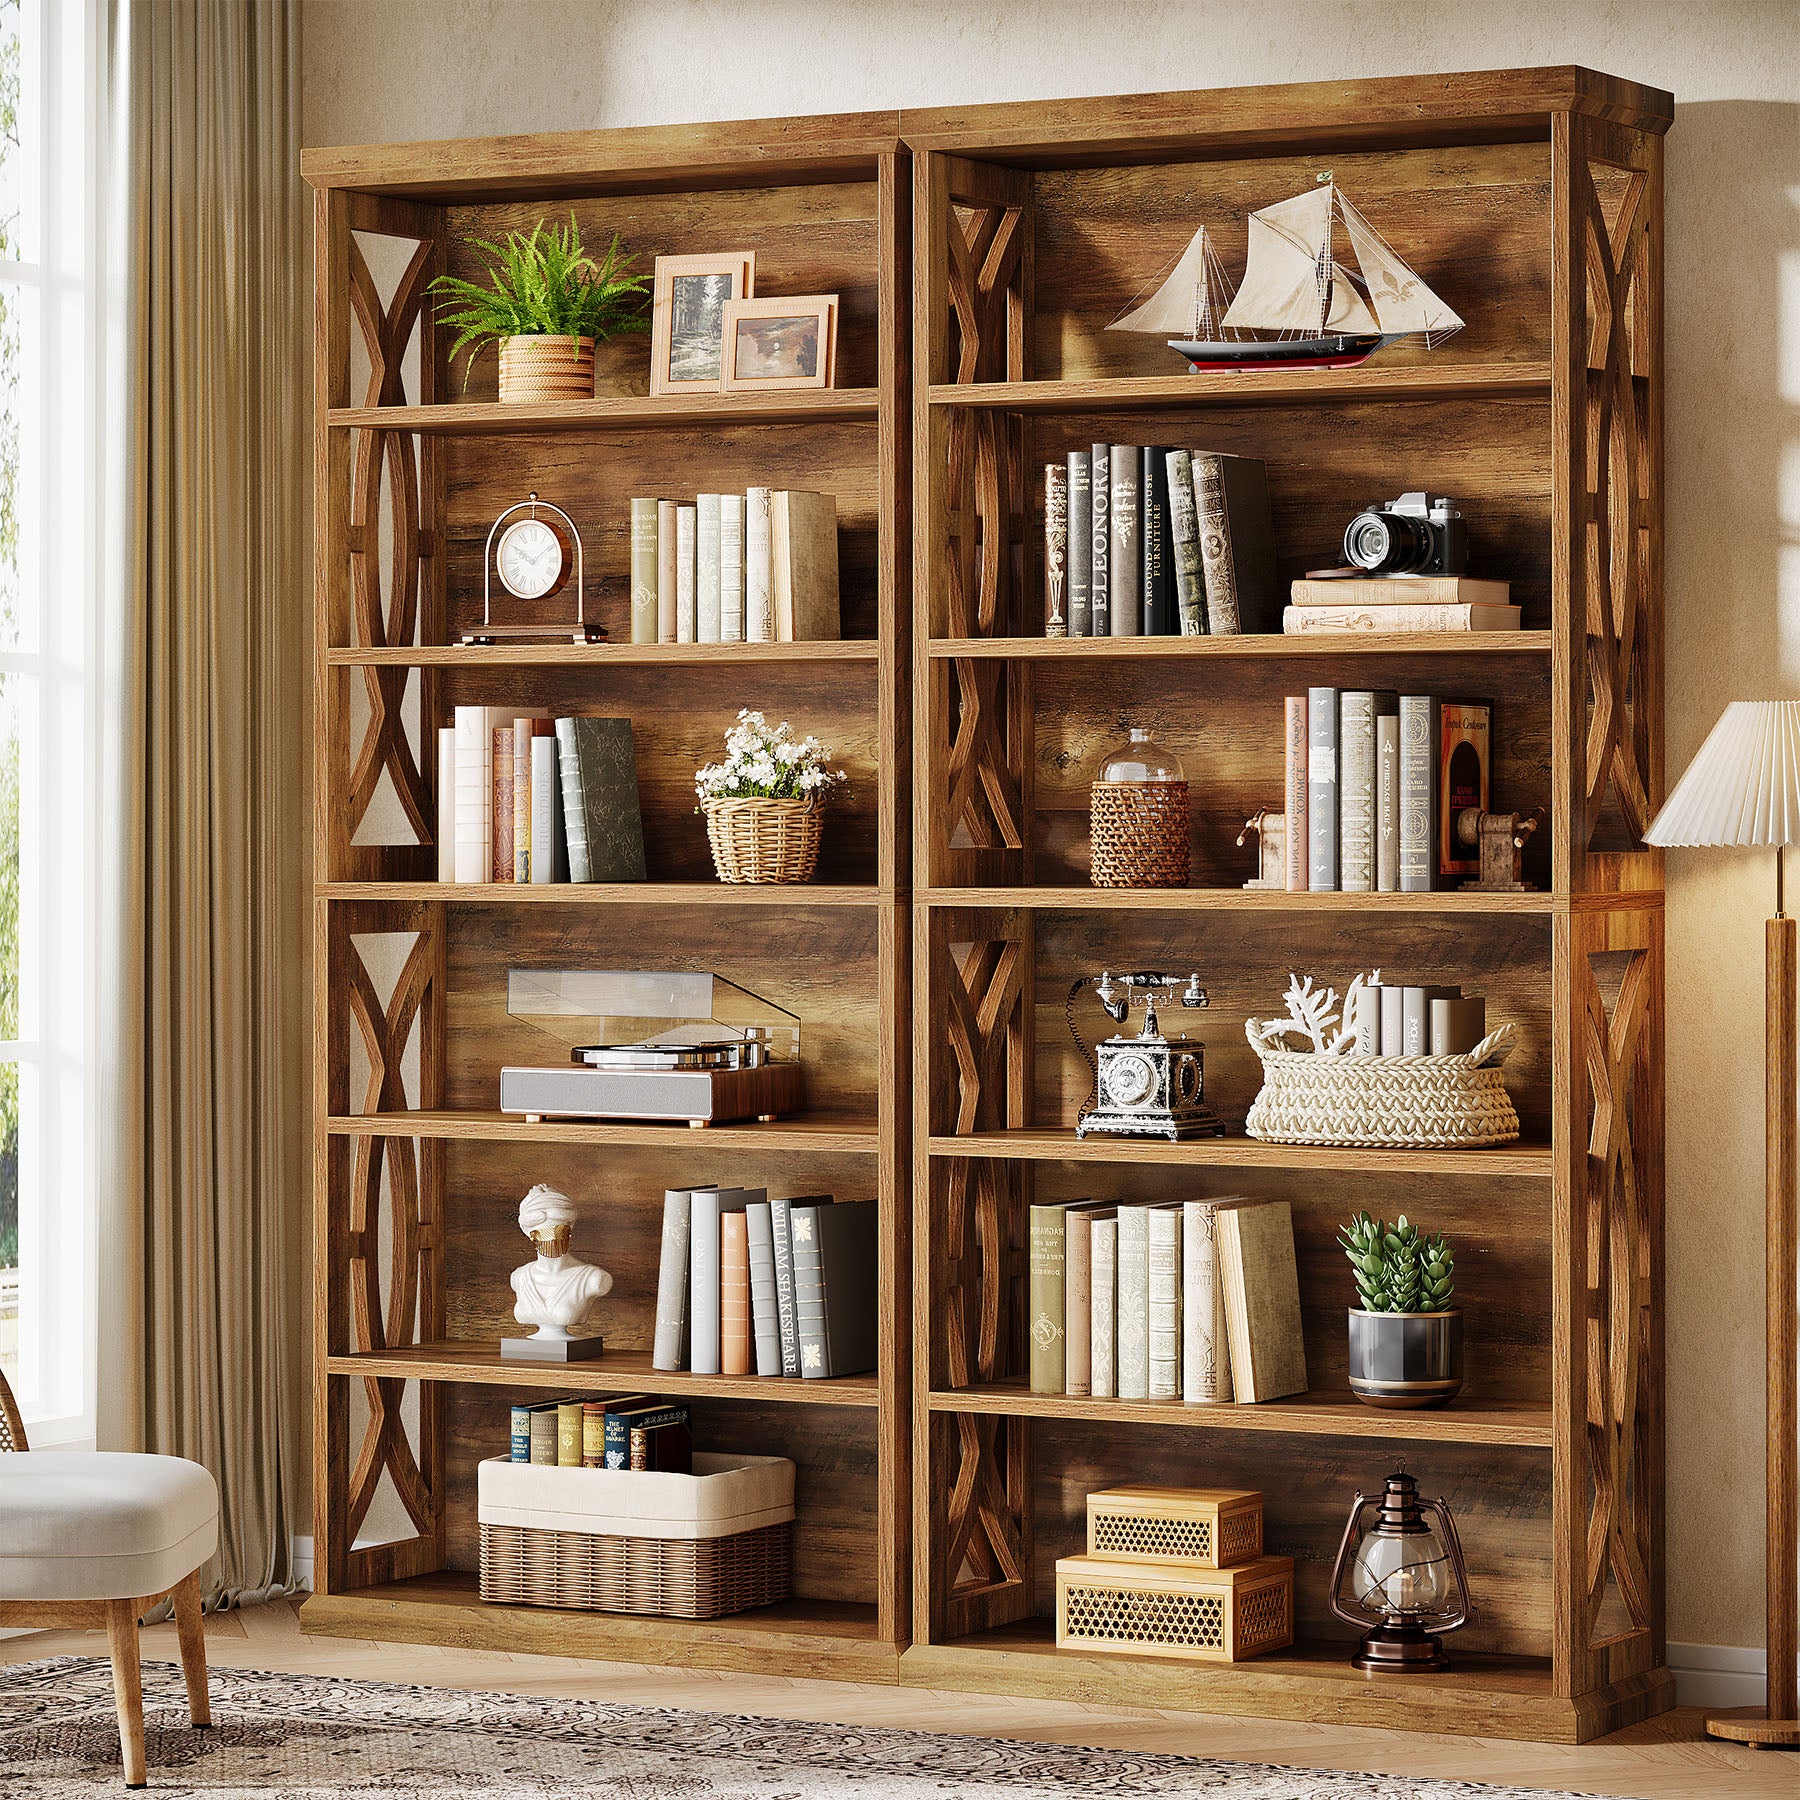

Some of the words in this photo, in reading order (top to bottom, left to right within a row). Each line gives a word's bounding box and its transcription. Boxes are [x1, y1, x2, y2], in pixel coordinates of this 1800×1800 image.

[1145, 474, 1153, 517] HOUSE
[1092, 455, 1108, 612] ELEONORA
[1145, 522, 1153, 548] THE
[1153, 503, 1161, 577] FURNITURE
[1145, 553, 1153, 607] AROUND
[540, 770, 549, 851] THUCYDIDES
[1296, 767, 1306, 816] ХОЛМСЕ
[1291, 828, 1300, 881] ЗАПИСКИ
[773, 1202, 789, 1269] WILLIAM
[777, 1274, 797, 1373] SHAKESPEARE
